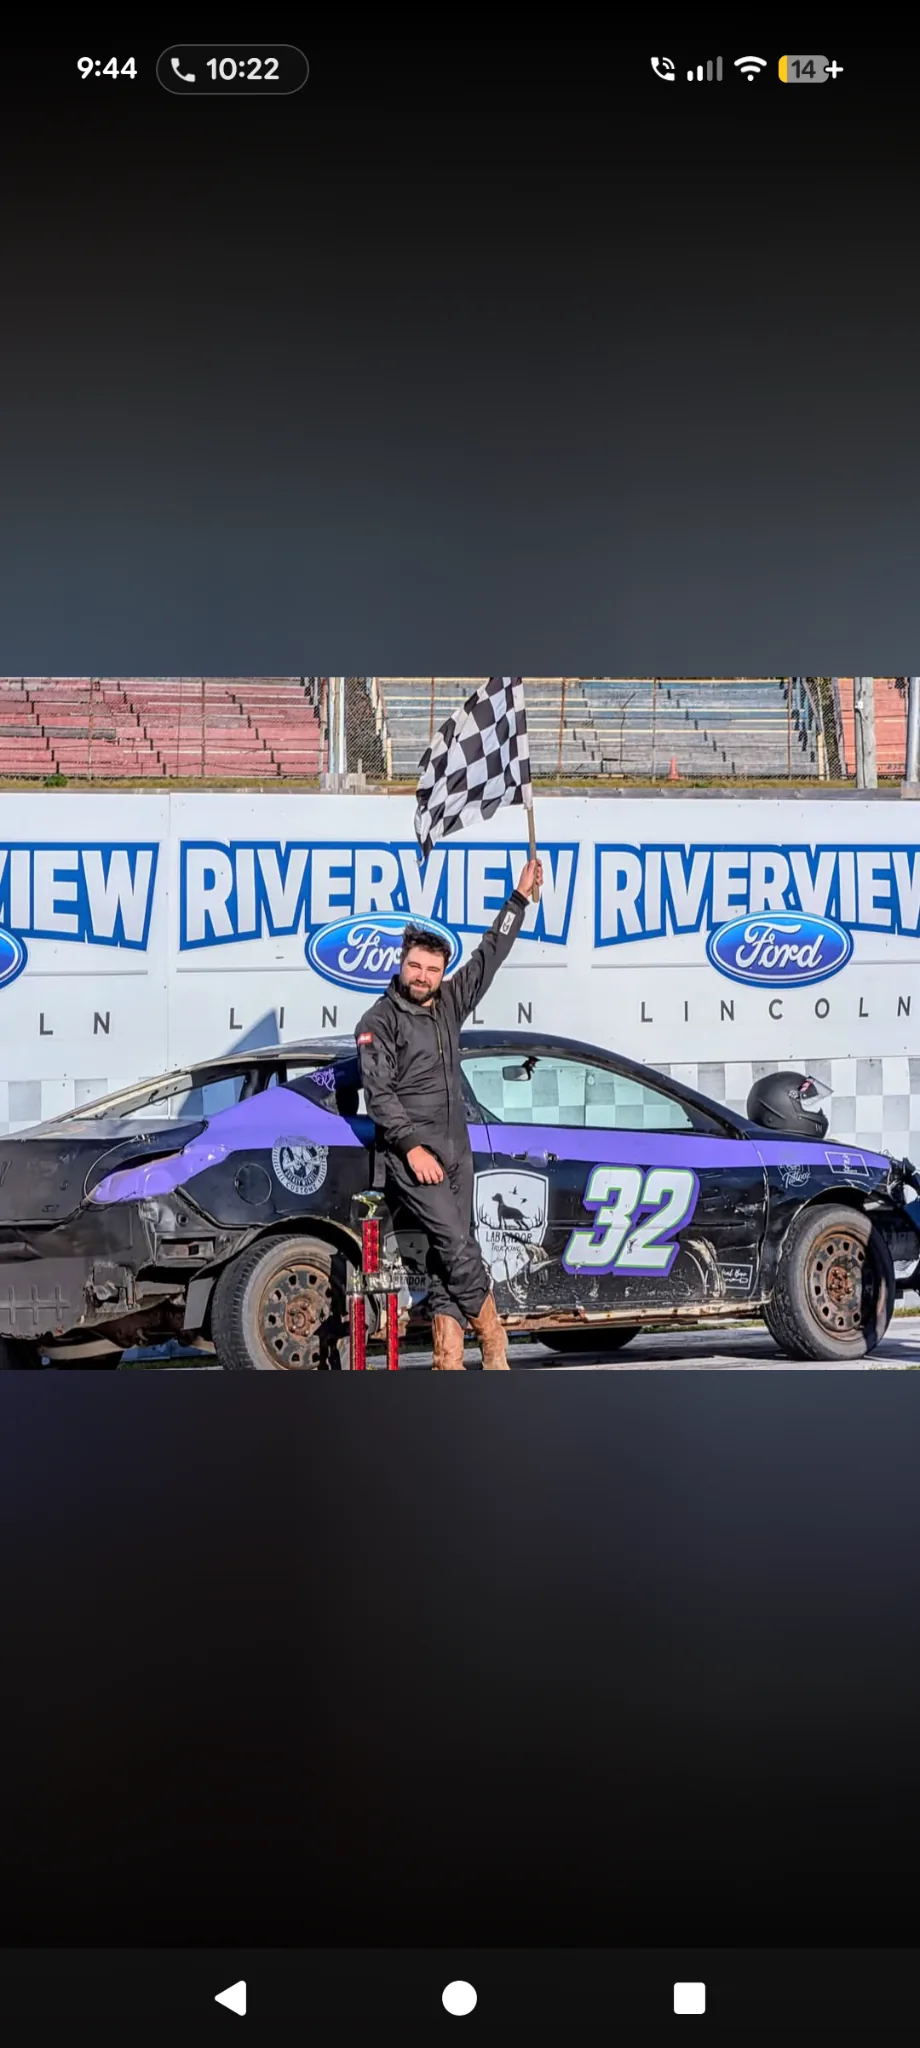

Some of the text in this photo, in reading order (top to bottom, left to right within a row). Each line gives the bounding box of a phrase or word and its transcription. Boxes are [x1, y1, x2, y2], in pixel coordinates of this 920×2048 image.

[0, 850, 153, 943] IEW
[186, 849, 575, 942] RIVERVIEW
[338, 923, 403, 973] For
[736, 922, 822, 969] Ford
[641, 995, 911, 1022] LINCOLN
[563, 1166, 698, 1272] 32
